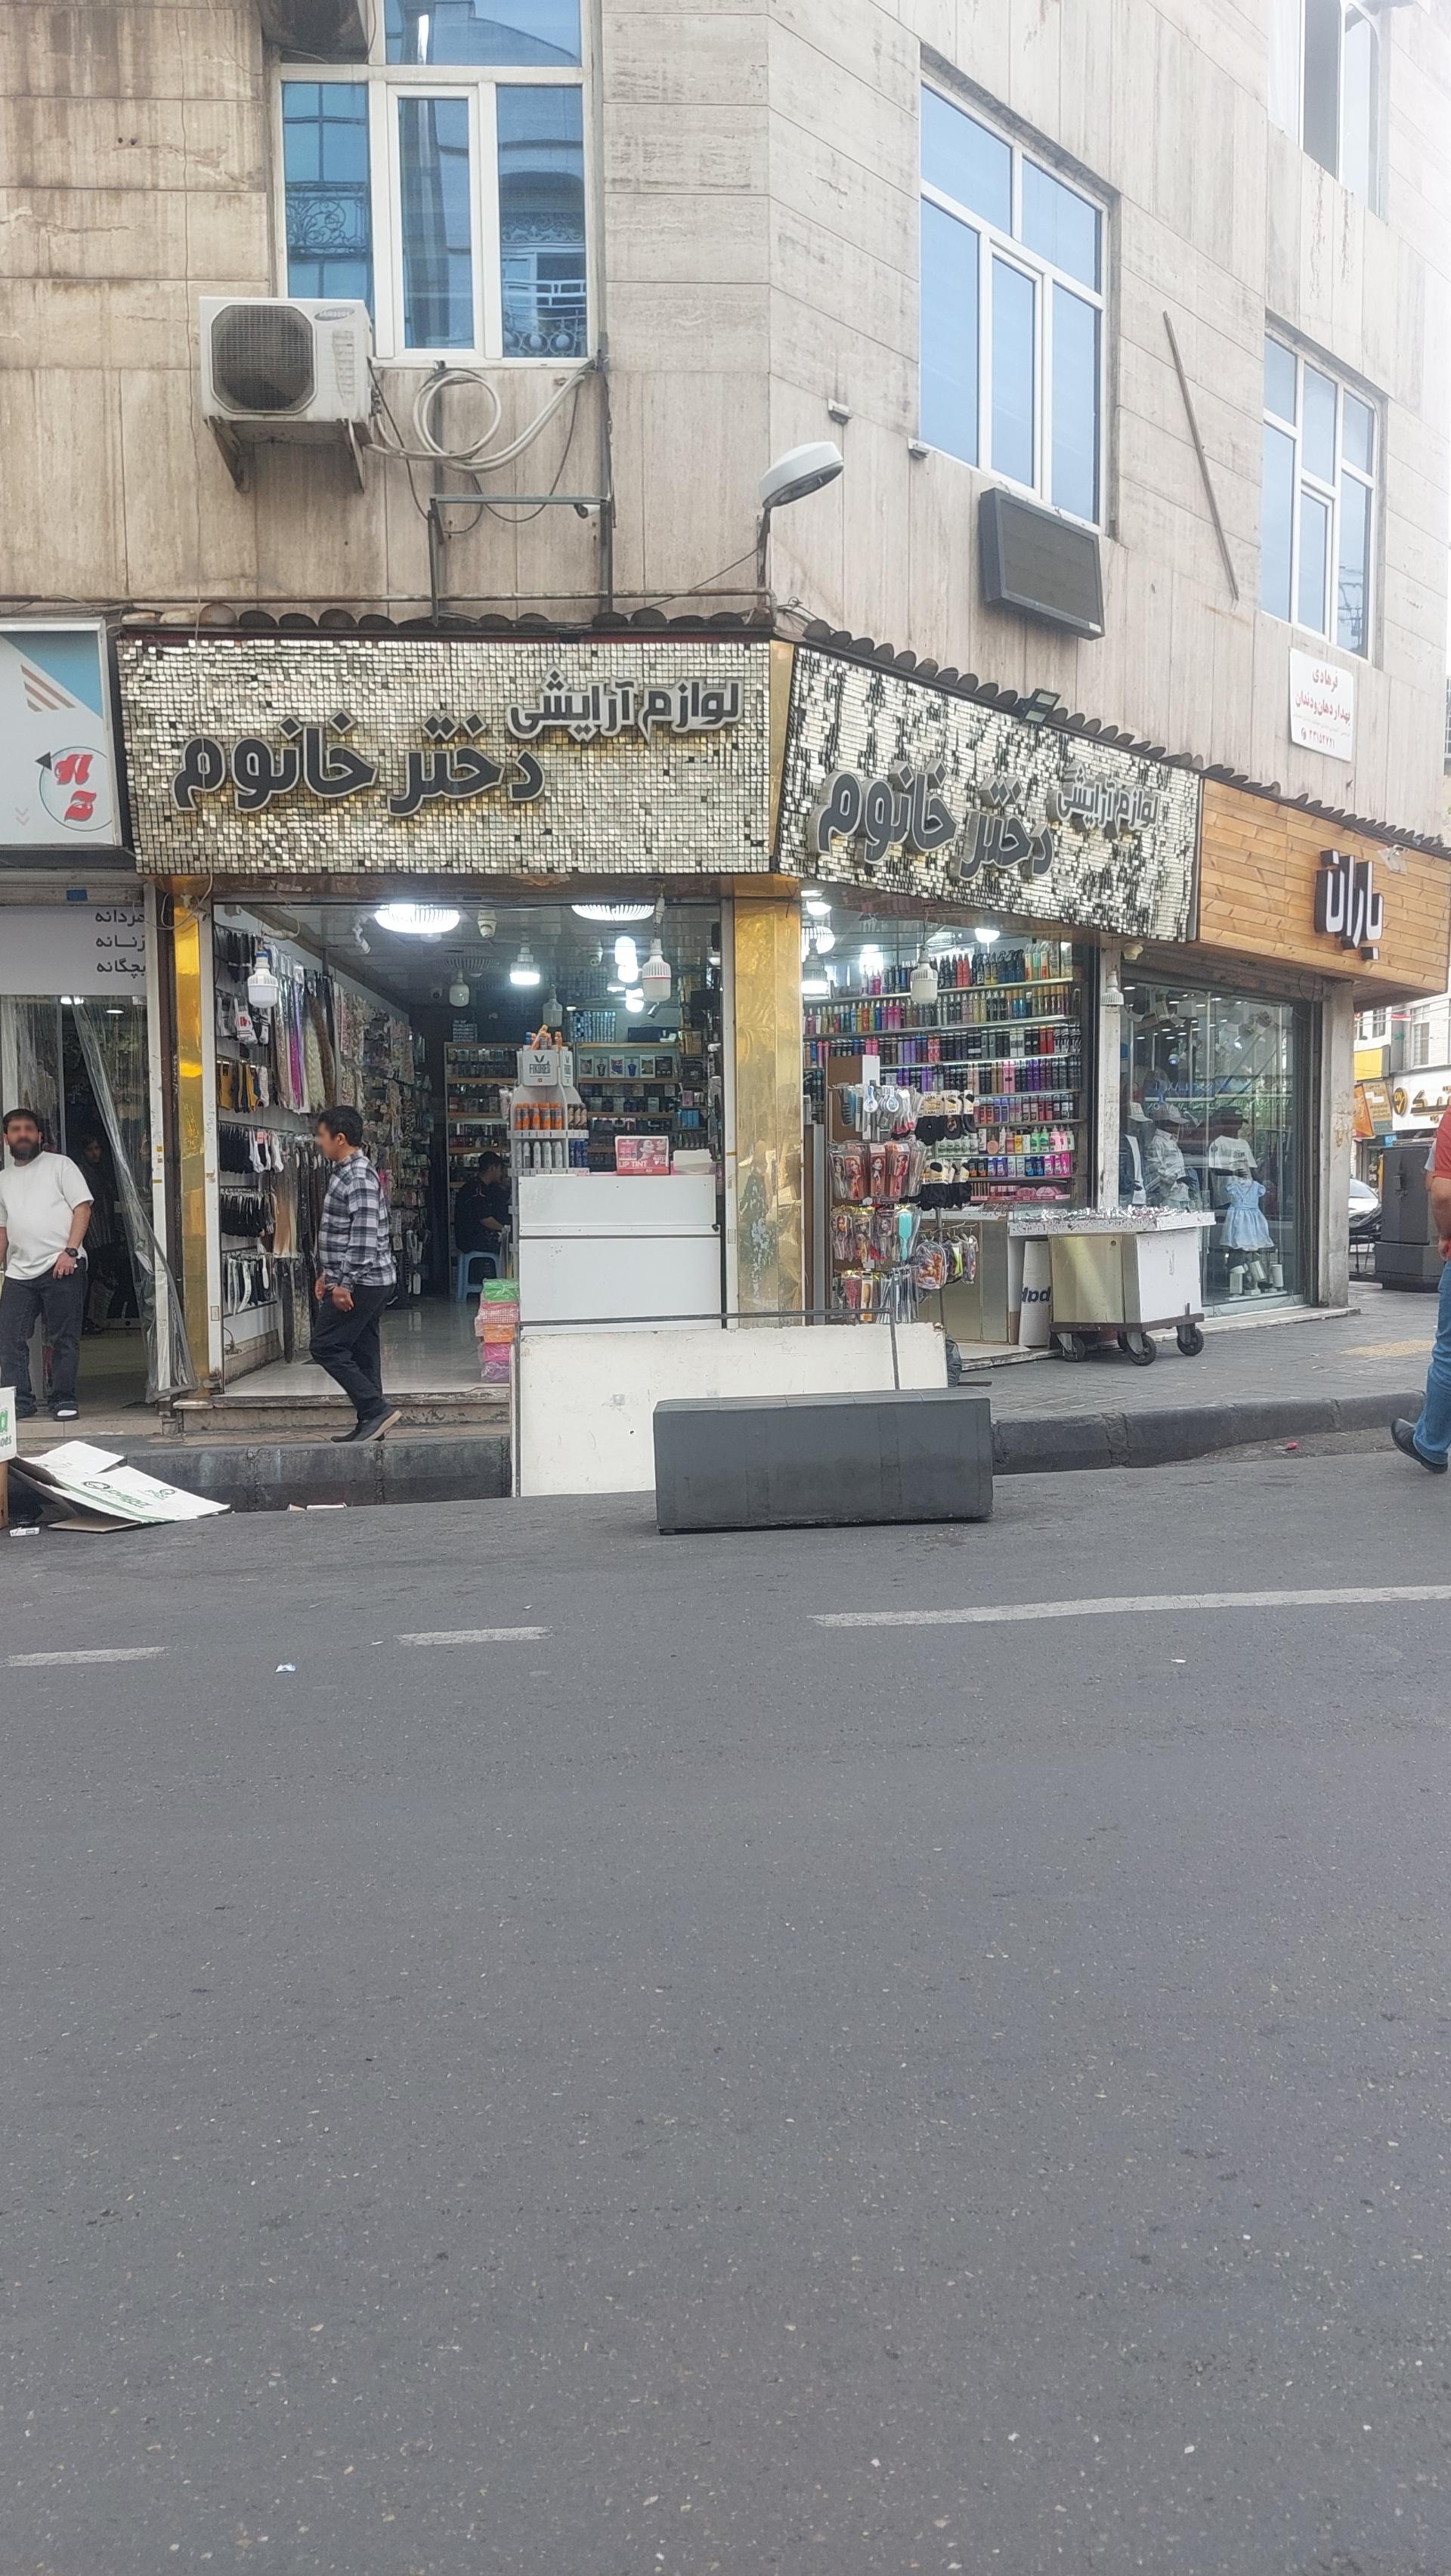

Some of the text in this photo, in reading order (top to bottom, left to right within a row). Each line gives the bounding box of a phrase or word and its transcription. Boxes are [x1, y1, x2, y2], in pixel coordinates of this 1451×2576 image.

[506, 666, 744, 741] لوازم آرایشی
[1313, 669, 1338, 691] فرهادی
[172, 708, 546, 817] دختر خانوم
[1053, 762, 1161, 837] لوازم آرایشی
[812, 759, 1053, 882] دختر خانوم
[96, 910, 144, 926] مردانه
[1314, 849, 1384, 960] باران
[97, 958, 146, 979] بچگانه
